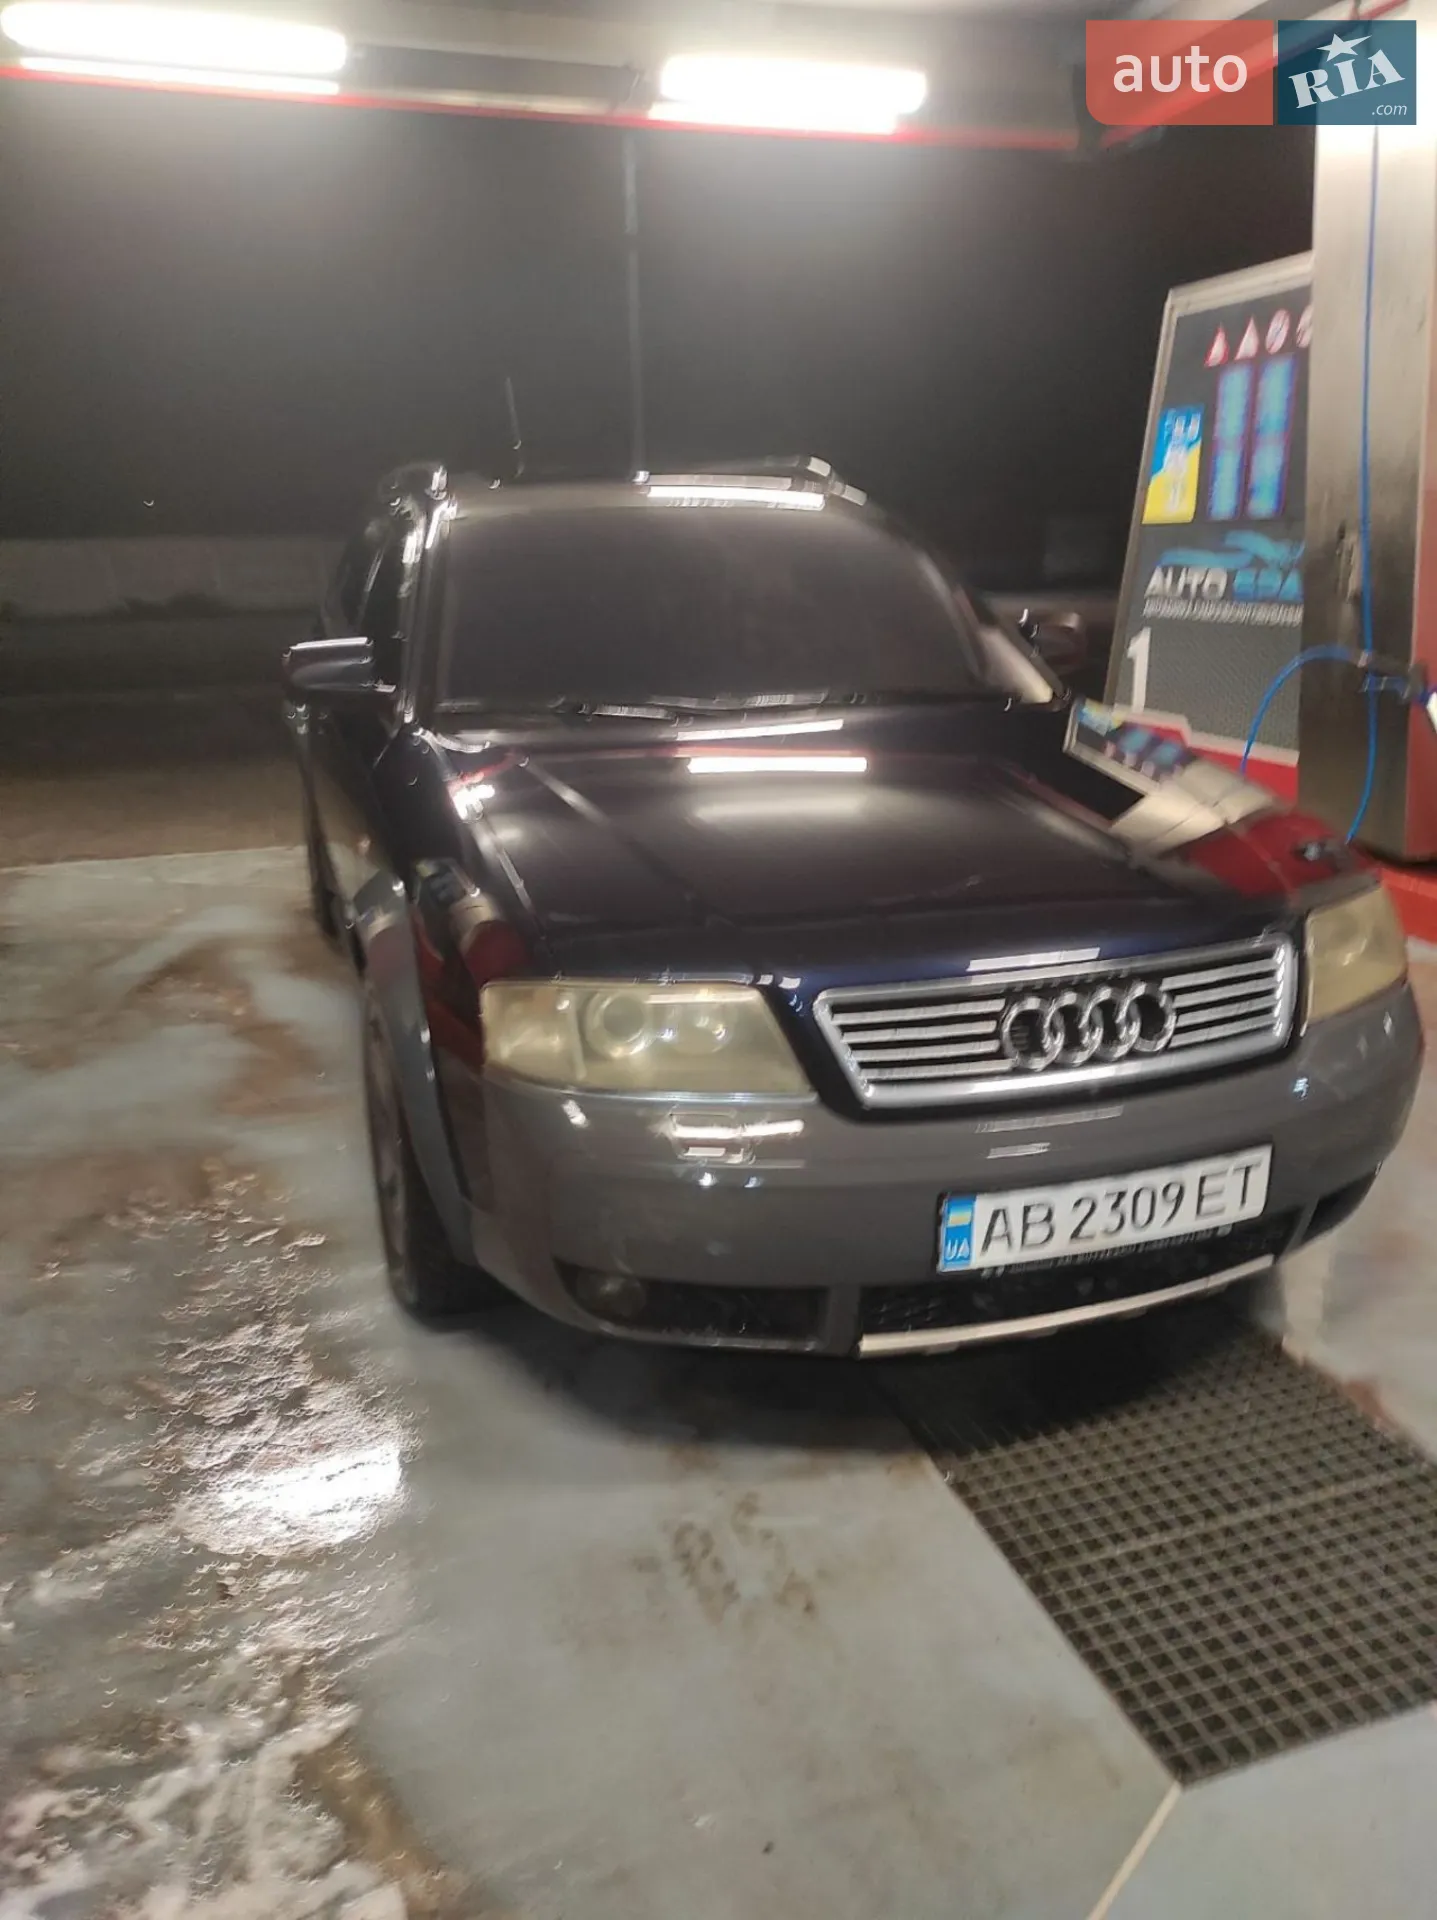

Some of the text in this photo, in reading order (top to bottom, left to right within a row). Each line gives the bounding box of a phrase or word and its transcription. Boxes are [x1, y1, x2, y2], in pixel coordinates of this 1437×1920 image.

[1143, 566, 1228, 601] AUTO
[1127, 626, 1151, 713] 1
[980, 1202, 1056, 1257] AB
[1068, 1180, 1187, 1244] 2309
[1195, 1160, 1263, 1220] ET
[944, 1237, 970, 1262] UA
